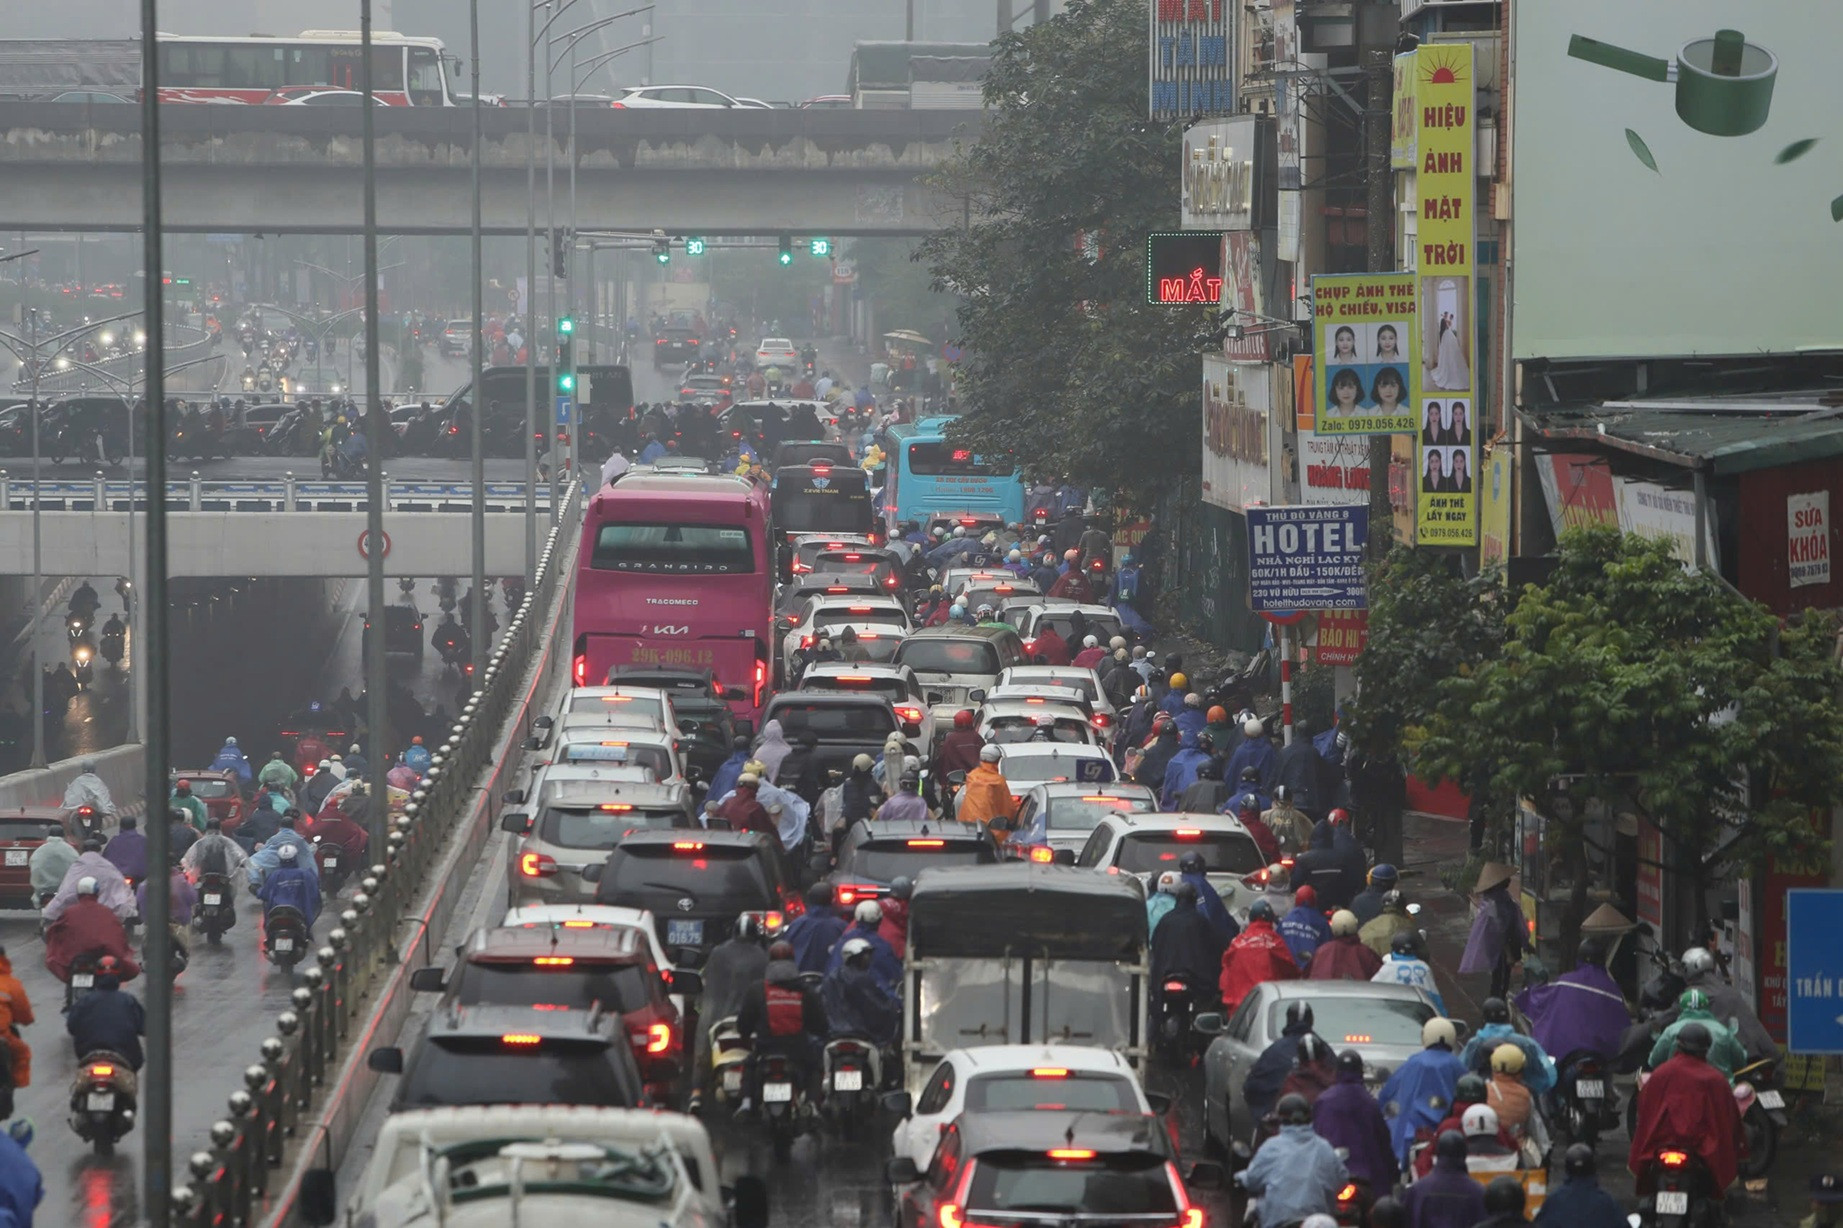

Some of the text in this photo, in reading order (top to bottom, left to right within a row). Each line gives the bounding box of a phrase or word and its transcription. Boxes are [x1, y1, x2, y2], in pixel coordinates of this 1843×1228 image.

[1160, 28, 1226, 68] TÂM
[1151, 79, 1233, 113] MINH
[1424, 103, 1466, 131] HIỆU
[1424, 148, 1462, 174] ẢNH
[1424, 195, 1462, 223] MẶT
[687, 241, 703, 254] 30
[812, 241, 828, 254] 30
[1424, 240, 1465, 265] TRỜI
[1161, 267, 1222, 301] MẮT
[1315, 282, 1414, 300] CHỤP ẢNH THẺ
[1315, 299, 1416, 318] HỘ CHIẾU, VISA
[1321, 418, 1415, 431] Zalo: 0979.056.426
[1430, 496, 1465, 508] ẢNH THẺ
[1266, 510, 1287, 520] THỦ
[1291, 510, 1305, 520] ĐÔ
[1309, 510, 1339, 520] VÀNG
[1427, 509, 1466, 521] LẤY NGAY
[1795, 501, 1823, 529] SỬA
[1254, 522, 1361, 554] HOTEL
[1790, 530, 1827, 563] KHÓA
[618, 562, 728, 571] GRANBIRD
[1252, 567, 1287, 578] 60K/1H
[1252, 589, 1267, 597] 230
[654, 625, 689, 635] KIA
[1320, 622, 1343, 648] BẢO
[1321, 651, 1346, 661] CHÍNH
